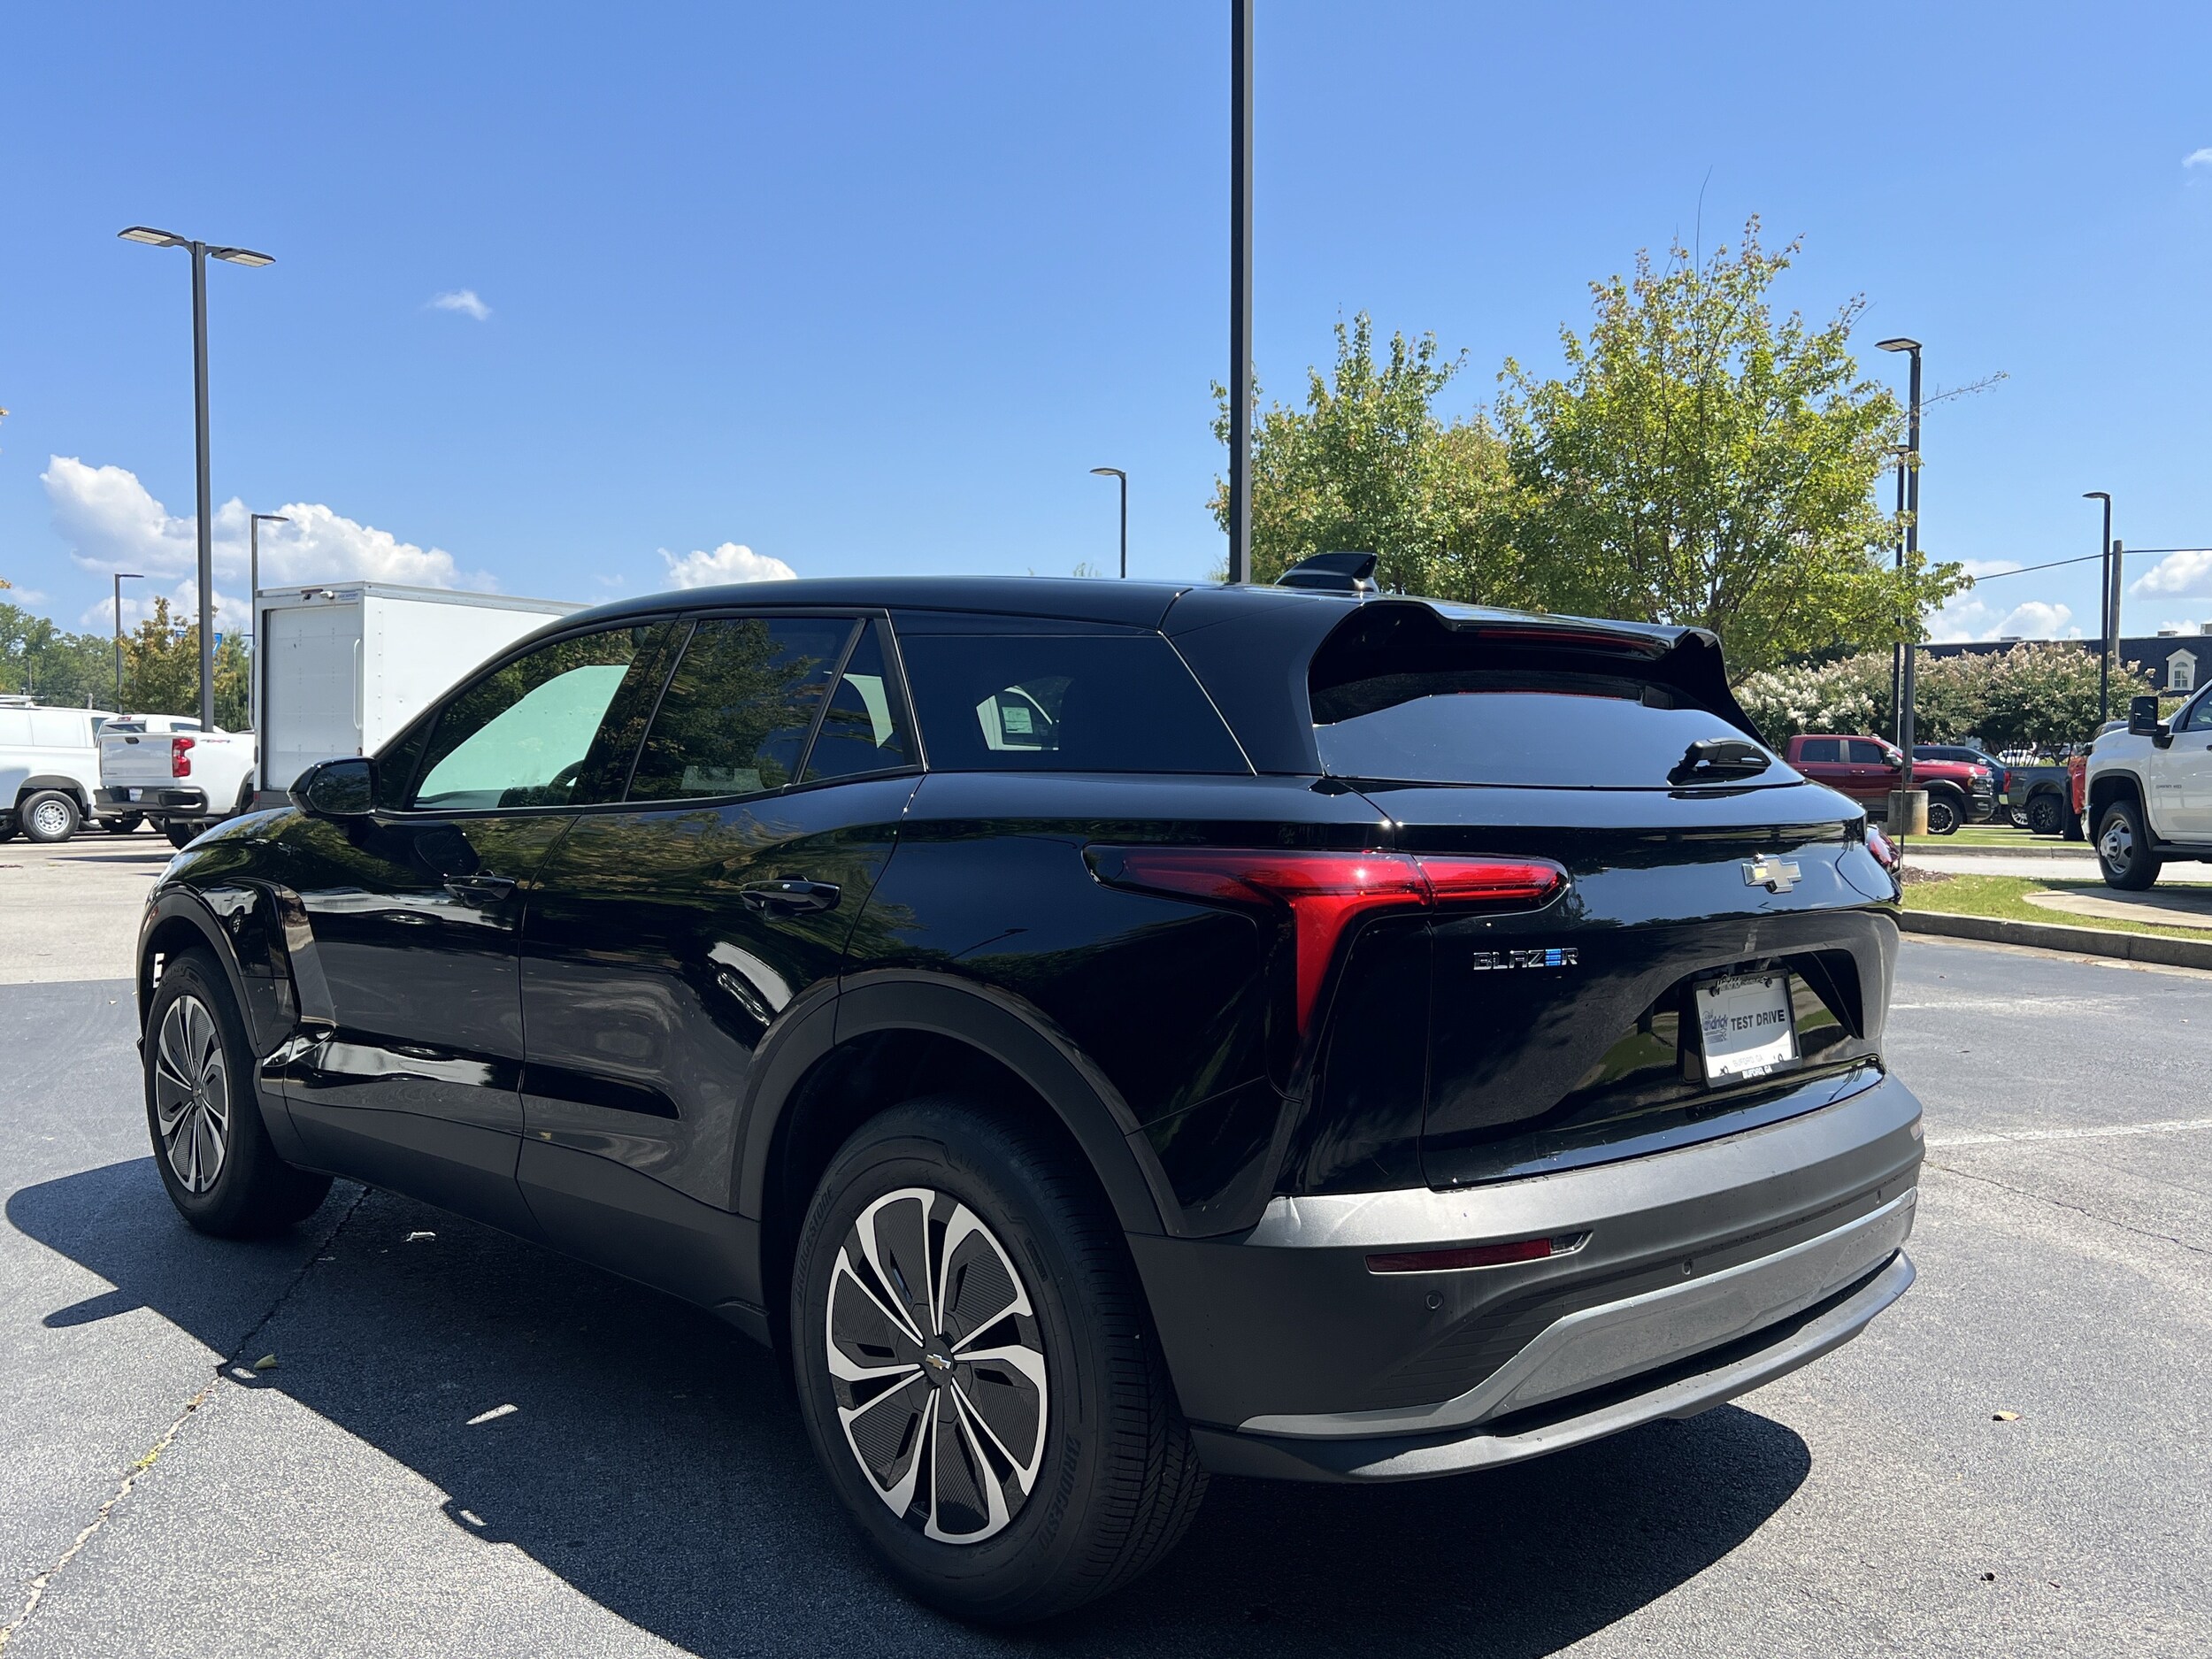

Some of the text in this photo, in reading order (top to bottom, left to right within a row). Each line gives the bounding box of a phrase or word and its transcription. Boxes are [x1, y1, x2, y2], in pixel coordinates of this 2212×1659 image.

[1473, 948, 1578, 970] BLAZER
[1731, 1010, 1785, 1031] TEST DRIVE
[1037, 1431, 1081, 1553] BRIDGESTO
